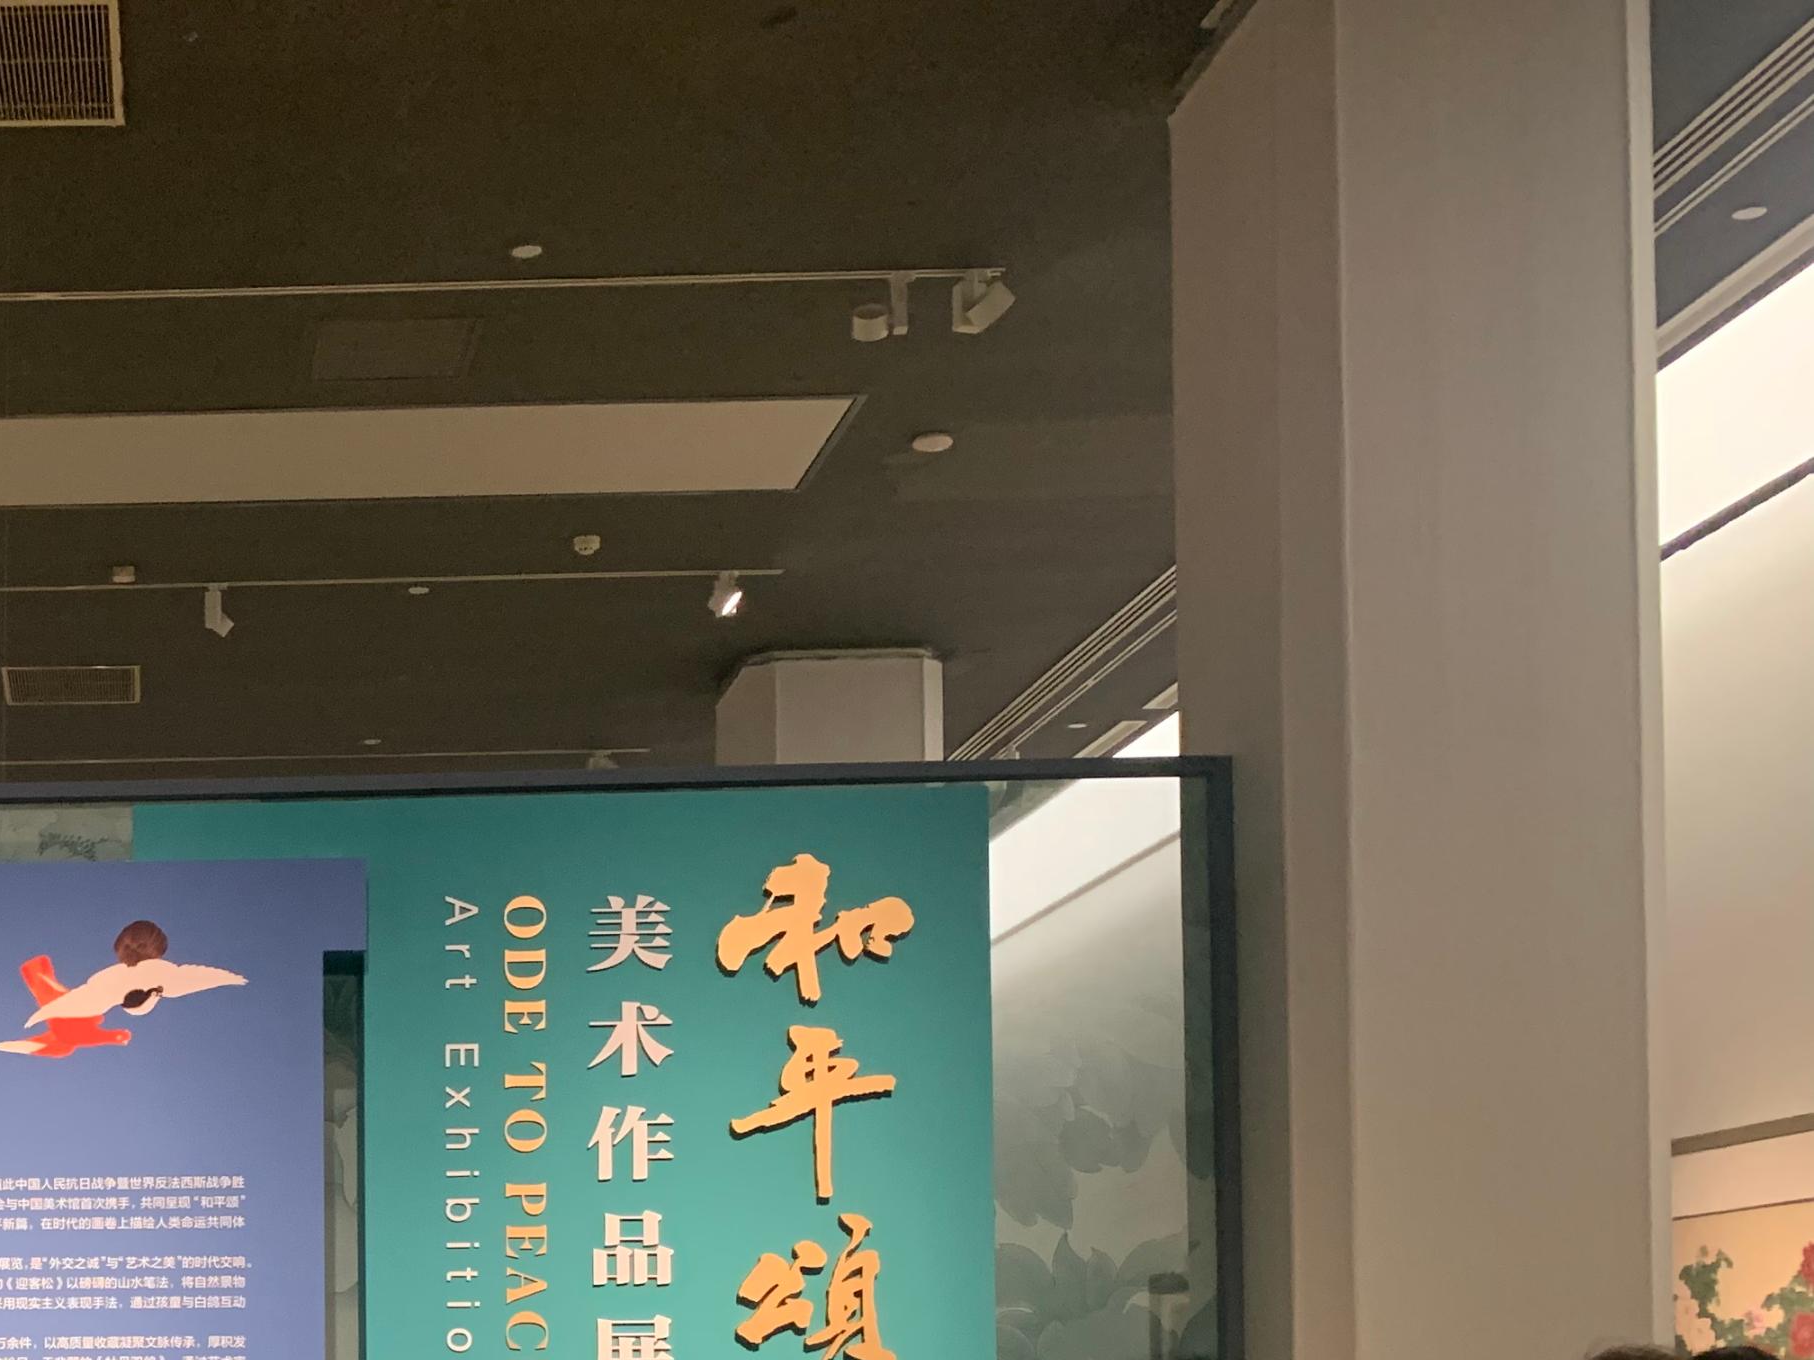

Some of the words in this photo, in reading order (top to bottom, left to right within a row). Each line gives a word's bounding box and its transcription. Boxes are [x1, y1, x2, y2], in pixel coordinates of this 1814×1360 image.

[443, 895, 480, 990] Art
[502, 894, 547, 1035] ODE
[502, 1060, 547, 1155] TO
